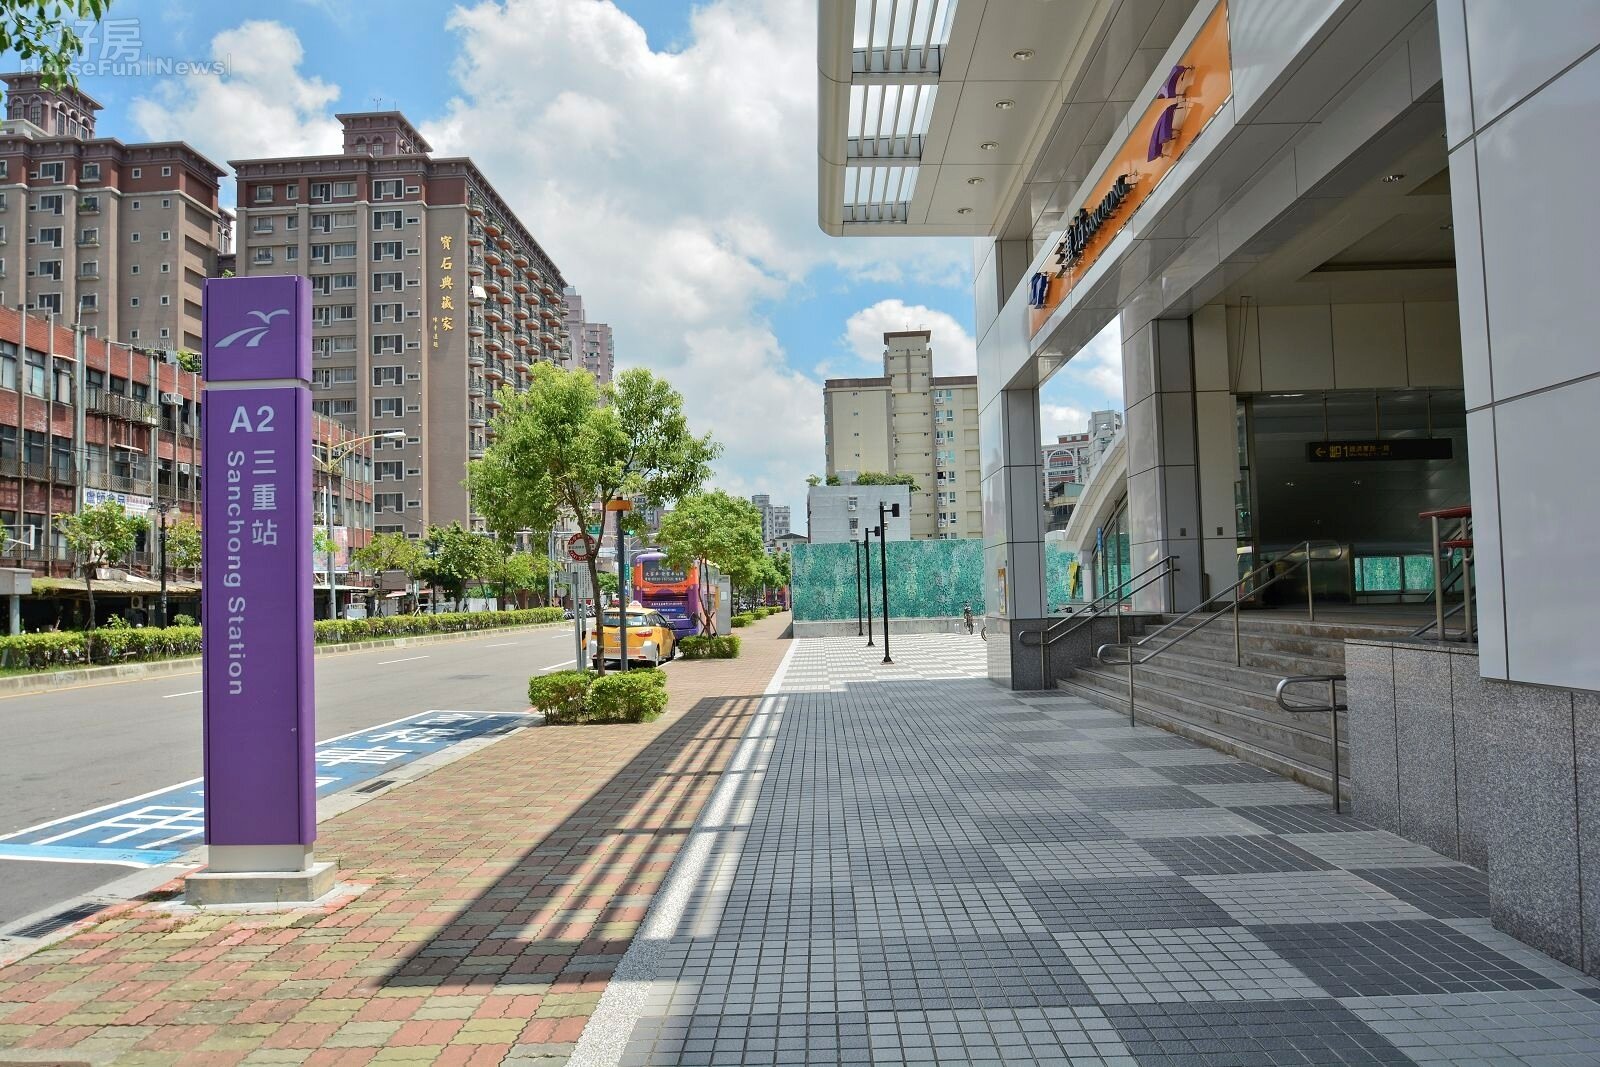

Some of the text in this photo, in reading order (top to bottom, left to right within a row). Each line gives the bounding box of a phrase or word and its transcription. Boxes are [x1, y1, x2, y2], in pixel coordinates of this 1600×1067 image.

[440, 235, 454, 331] 寶石典藏家
[229, 405, 275, 433] A2
[251, 449, 278, 546] 三重站
[223, 450, 246, 695] Sanchong Station
[30, 713, 498, 849] 計程車用
